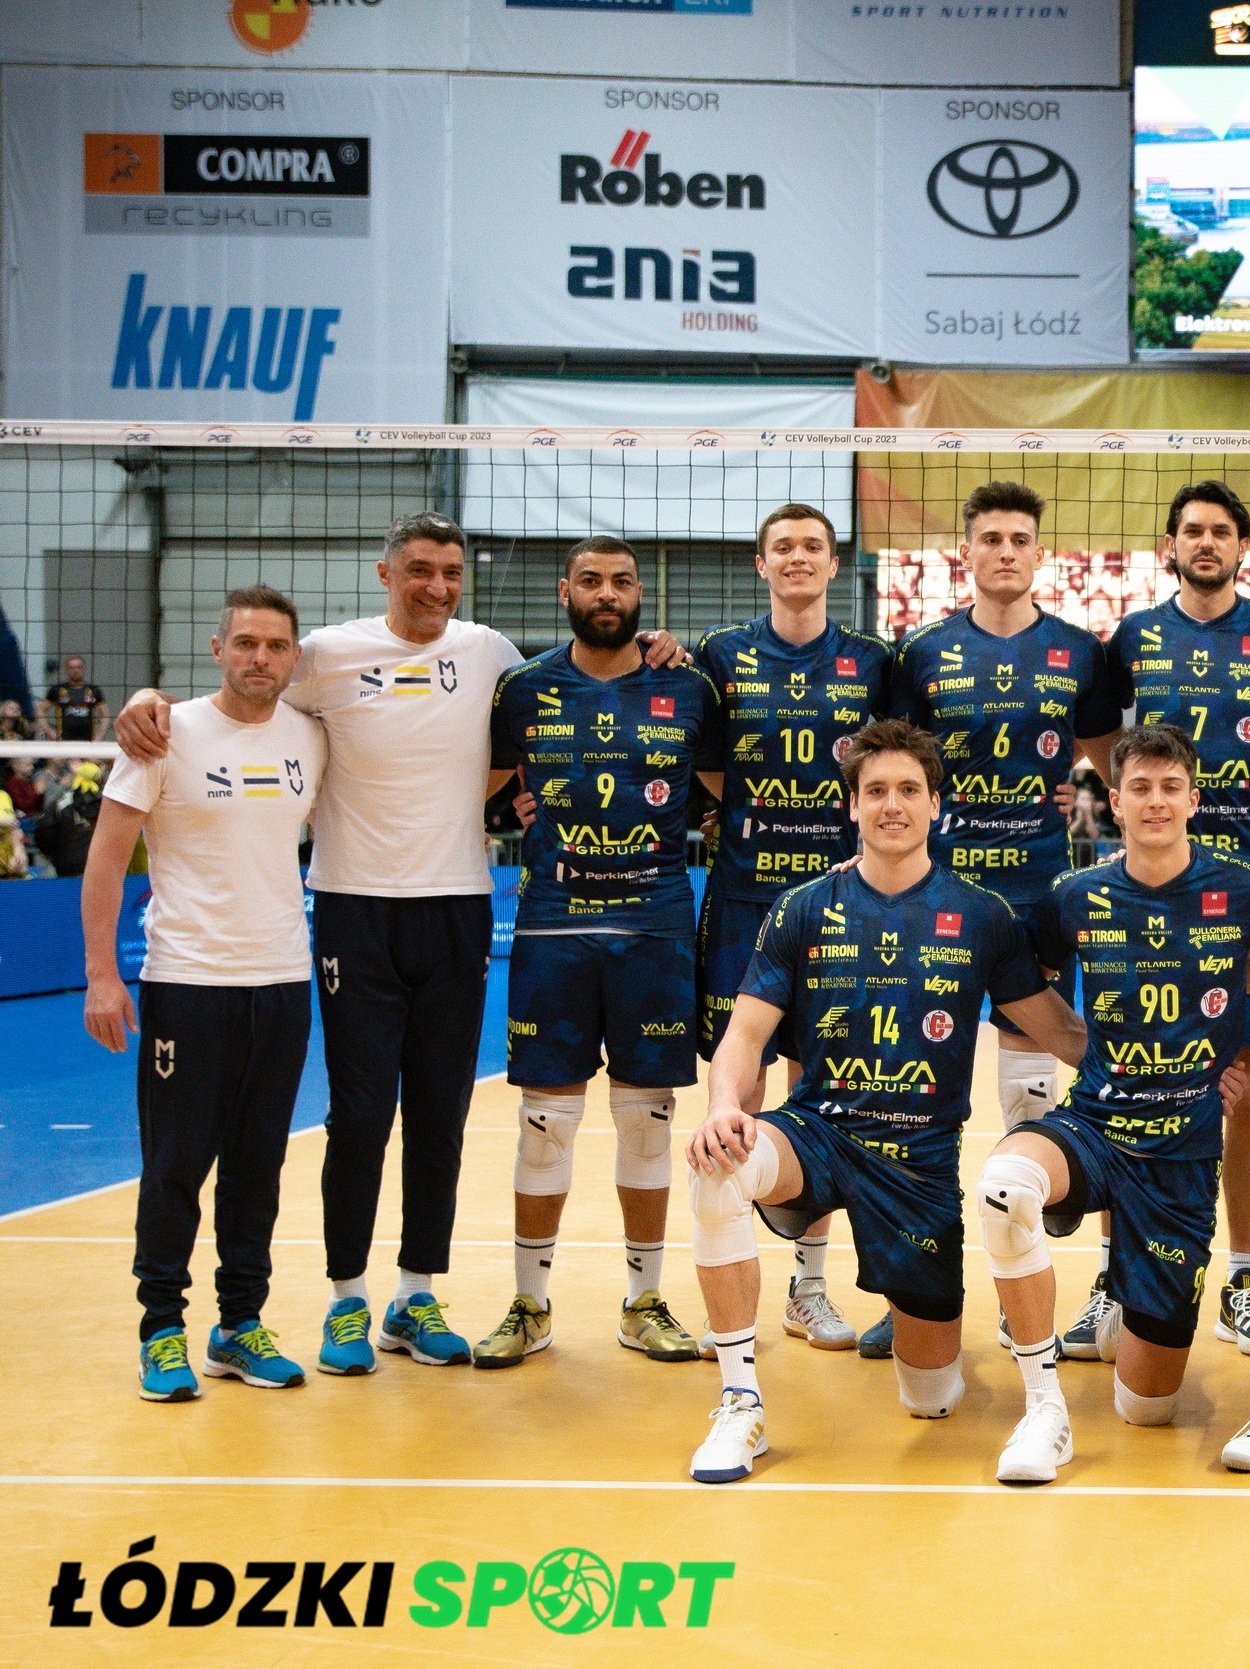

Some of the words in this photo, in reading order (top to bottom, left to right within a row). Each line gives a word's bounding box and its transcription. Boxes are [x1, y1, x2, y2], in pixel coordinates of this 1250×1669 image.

[851, 6, 927, 18] SPORT
[941, 7, 1070, 19] NUTRITION
[170, 89, 285, 111] SPONSOR
[604, 88, 720, 111] SPONSOR
[946, 100, 1061, 121] SPONSOR
[196, 146, 336, 183] COMPRA
[681, 311, 758, 333] HOLDING
[925, 309, 1004, 341] Sabaj
[1013, 310, 1082, 336] Łódź
[12, 426, 43, 437] CEV
[126, 433, 151, 442] PGE
[380, 430, 399, 440] CEV
[401, 430, 446, 442] Volleyball
[449, 431, 468, 443] Cup
[470, 431, 492, 440] 2023
[208, 434, 233, 444] PGE
[289, 435, 314, 444] PGE
[532, 437, 556, 446] PGE
[613, 437, 638, 447] PGE
[693, 438, 719, 447] PGE
[785, 434, 805, 443] CEV
[806, 434, 851, 445] Volleyball
[854, 434, 873, 446] Cup
[875, 435, 897, 444] 2023
[937, 440, 963, 449] PGE
[1019, 440, 1045, 449] PGE
[1192, 436, 1211, 445] CEV
[1100, 441, 1126, 450] PGE
[1141, 644, 1161, 652] nine
[735, 666, 757, 675] nine
[939, 663, 962, 673] nine
[1141, 659, 1172, 670] TIRONI
[736, 682, 770, 693] TIRONI
[938, 676, 975, 690] TIRONI
[538, 708, 561, 716] nine
[1190, 706, 1208, 741] 7
[537, 724, 575, 736] TIRONI
[780, 728, 814, 763] 10
[993, 722, 1010, 758] 6
[745, 778, 843, 799] VALSA
[952, 774, 1046, 794] VALSA
[207, 789, 233, 798] nine
[597, 772, 615, 809] 9
[765, 798, 826, 808] GROUP
[966, 794, 1027, 804] GROUP
[772, 824, 842, 834] PerkinElmer
[970, 817, 1043, 829] PerkinElmer
[557, 823, 661, 845] VALSA
[575, 845, 641, 855] GROUP
[1089, 911, 1111, 919] nine
[821, 925, 846, 935] nine
[1090, 930, 1127, 942] TIRONI
[1189, 926, 1241, 936] BULLONERIA
[1201, 932, 1241, 942] EMILIANA
[820, 944, 859, 958] TIRONI
[865, 977, 908, 985] ATLANTIC
[924, 974, 959, 996] VEM
[1140, 983, 1179, 1023] 90
[870, 1005, 900, 1045] 14
[1106, 1038, 1216, 1064] VALSA
[825, 1057, 936, 1083] VALSA
[1125, 1063, 1194, 1076] GROUP
[847, 1080, 911, 1093] GROUP
[848, 1108, 933, 1123] PerkinElmer
